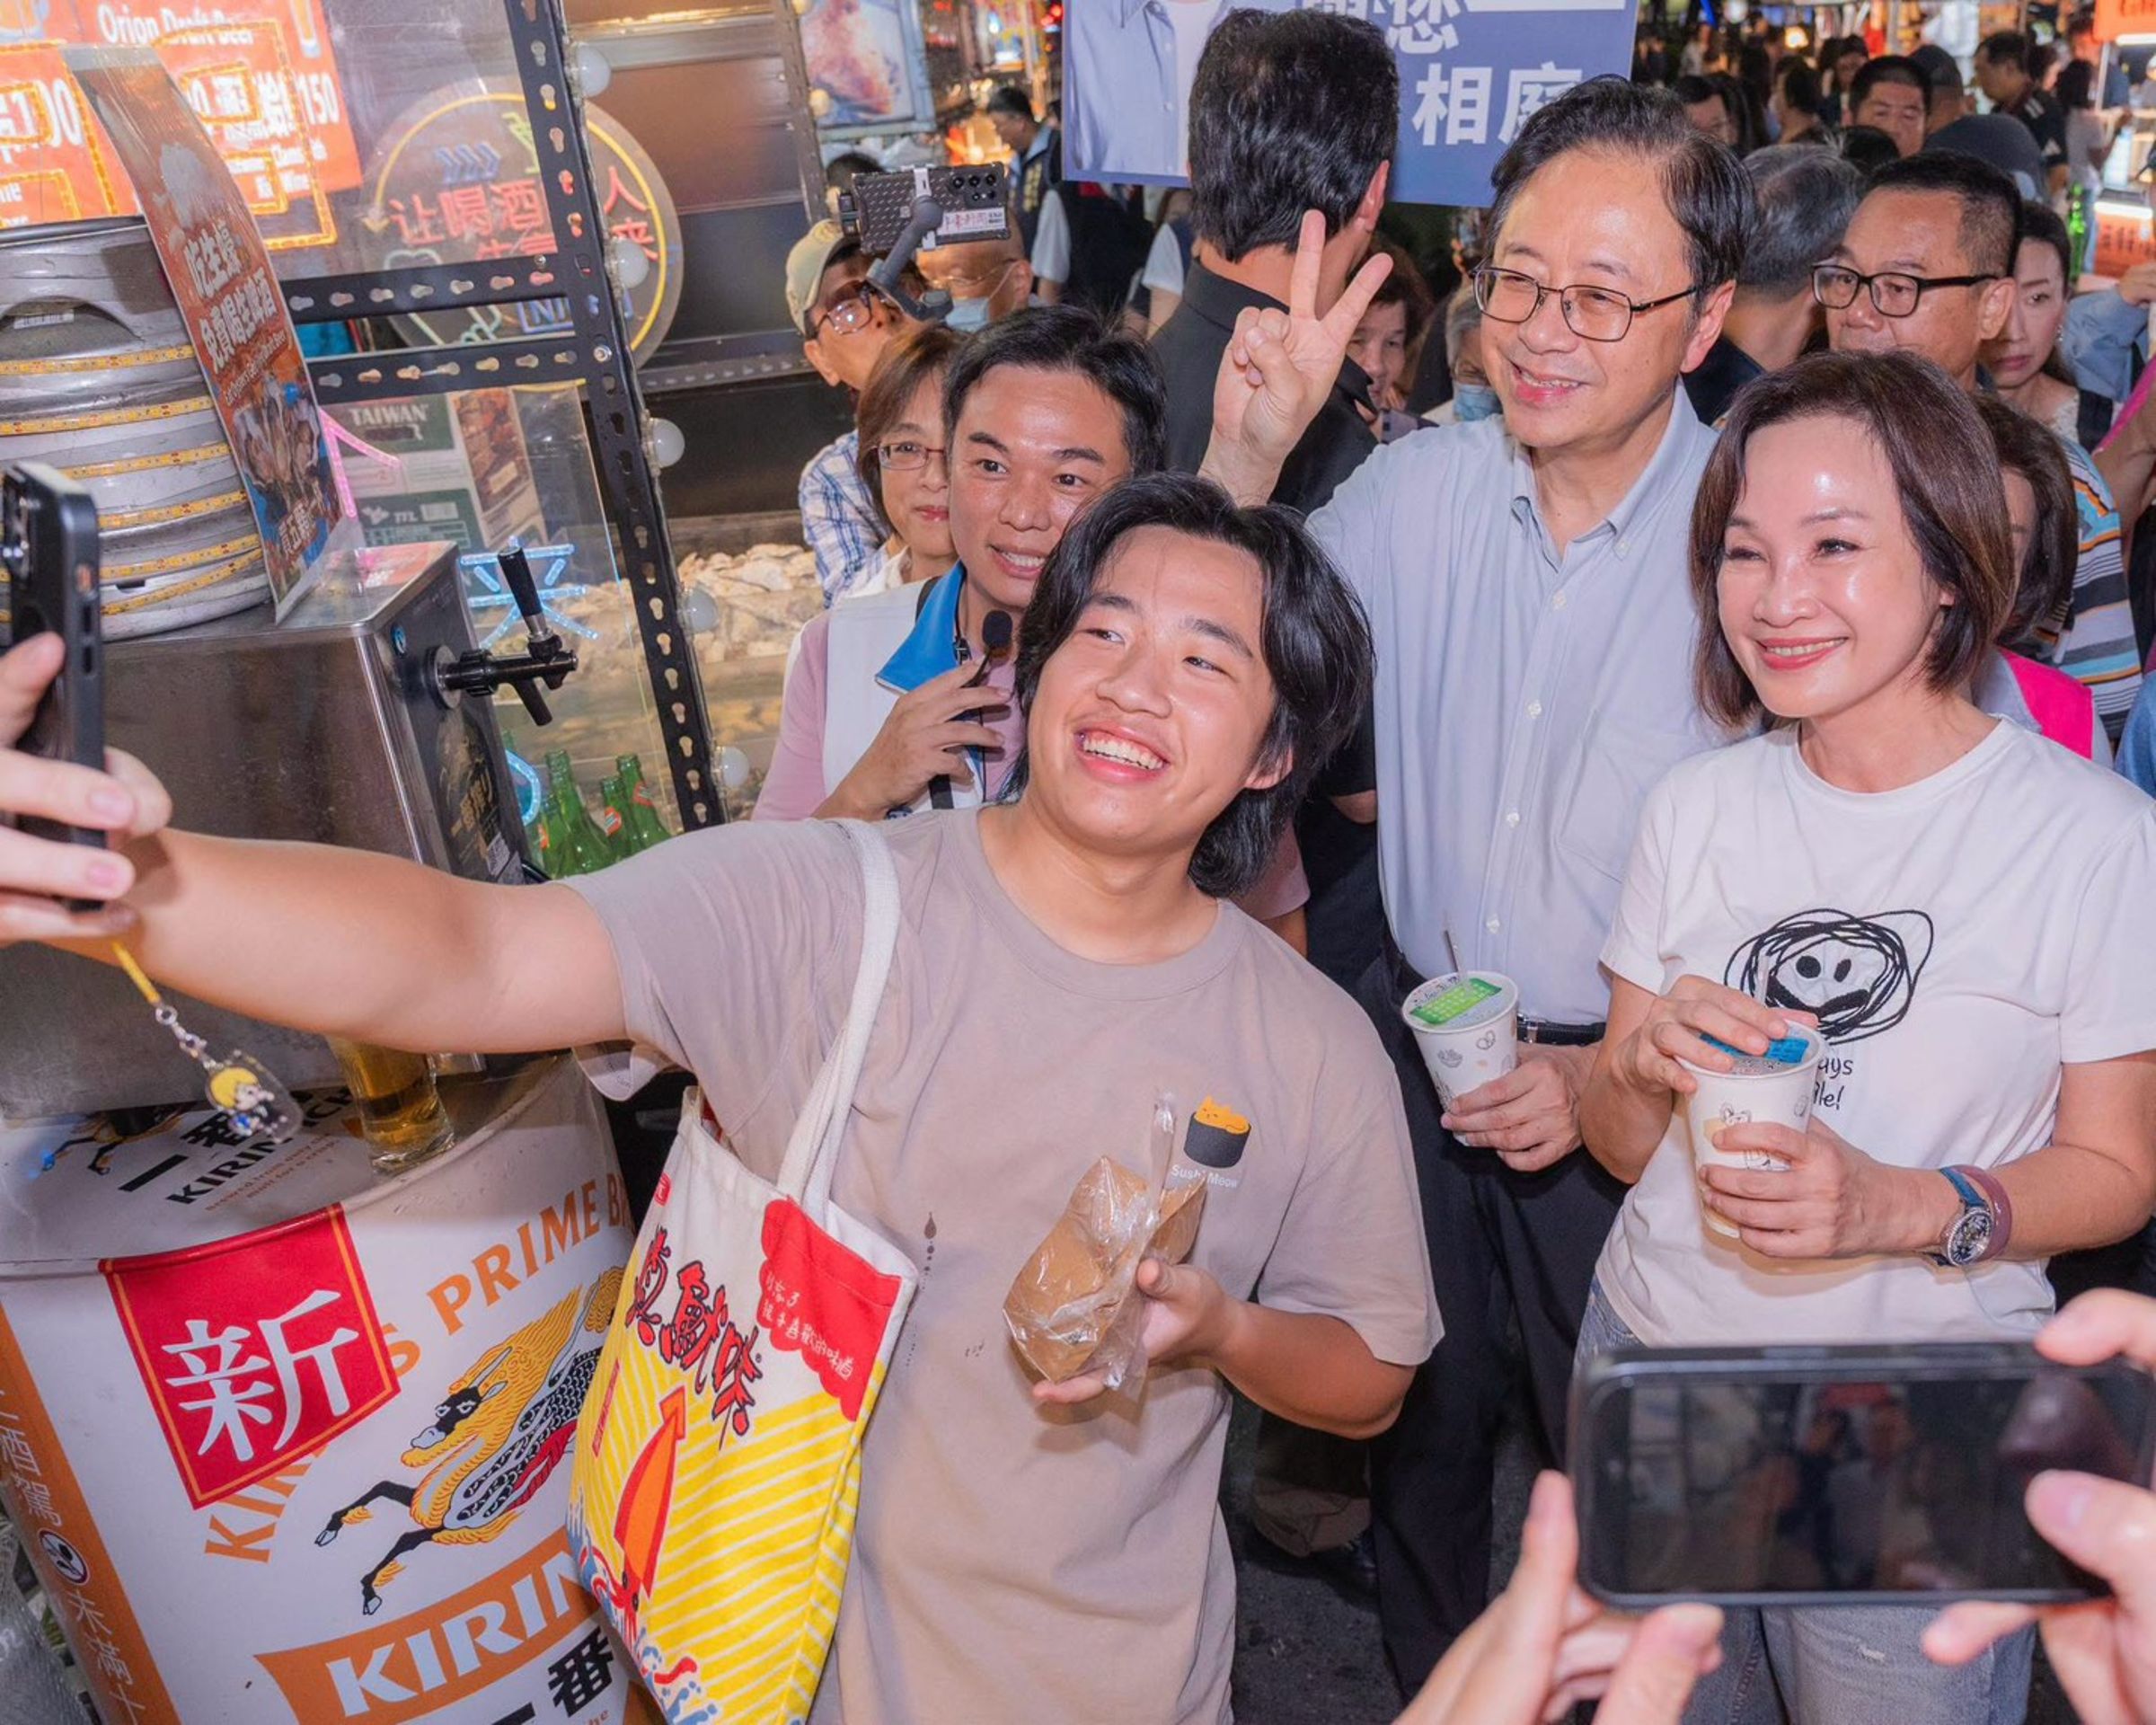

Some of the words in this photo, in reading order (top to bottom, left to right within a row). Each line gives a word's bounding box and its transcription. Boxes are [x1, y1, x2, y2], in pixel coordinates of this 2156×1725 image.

[97, 3, 160, 45] Orion
[295, 71, 341, 125] 150
[348, 402, 429, 427] TAIWAN
[1817, 1057, 1854, 1079] ays
[1813, 1080, 1845, 1110] ile!
[427, 1179, 601, 1336] PRIME
[162, 1289, 359, 1462] 新
